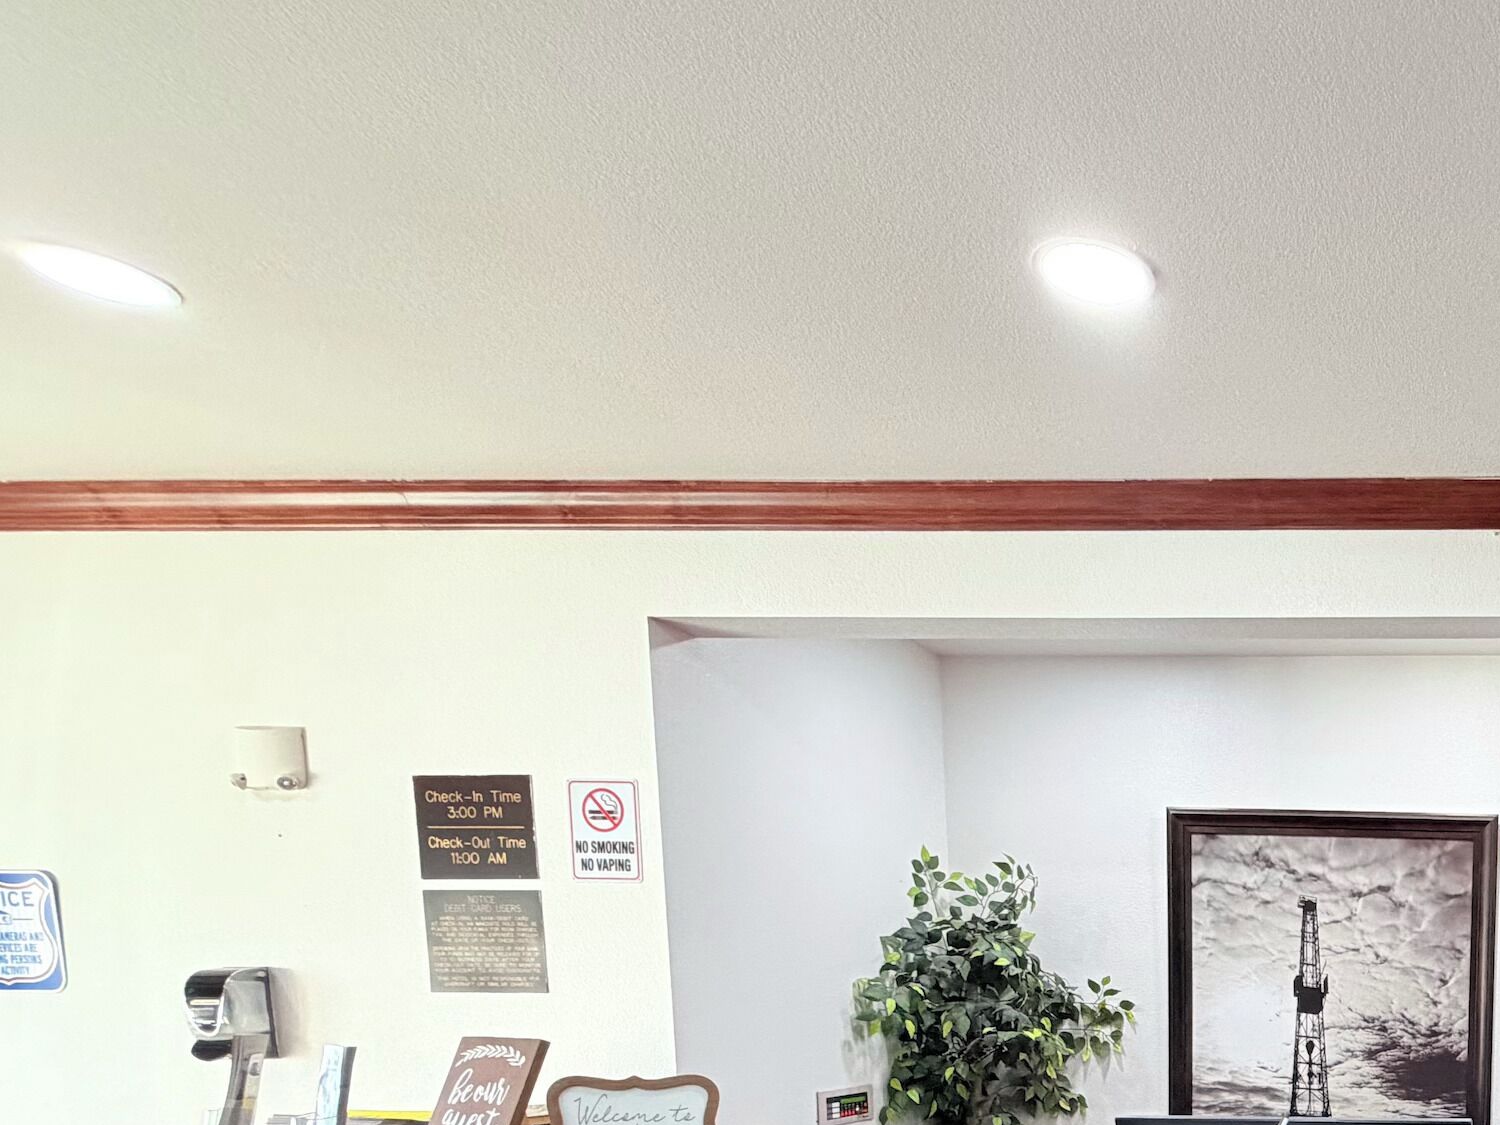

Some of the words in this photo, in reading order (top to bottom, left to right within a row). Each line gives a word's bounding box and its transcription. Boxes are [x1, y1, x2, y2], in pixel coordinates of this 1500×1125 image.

[425, 790, 484, 803] Check-In
[490, 790, 522, 803] Time
[447, 806, 477, 818] 3:00
[483, 806, 503, 818] PM
[428, 836, 490, 849] Check-Out
[498, 836, 526, 848] Time
[575, 841, 589, 854] NO
[591, 840, 635, 855] SMOKING
[451, 852, 480, 865] 11:00
[487, 852, 507, 864] AM
[581, 858, 595, 871] NO
[597, 858, 632, 872] VAPING
[466, 895, 497, 904] NOTICE
[574, 1093, 666, 1125] Welcome
[668, 1101, 697, 1122] to
